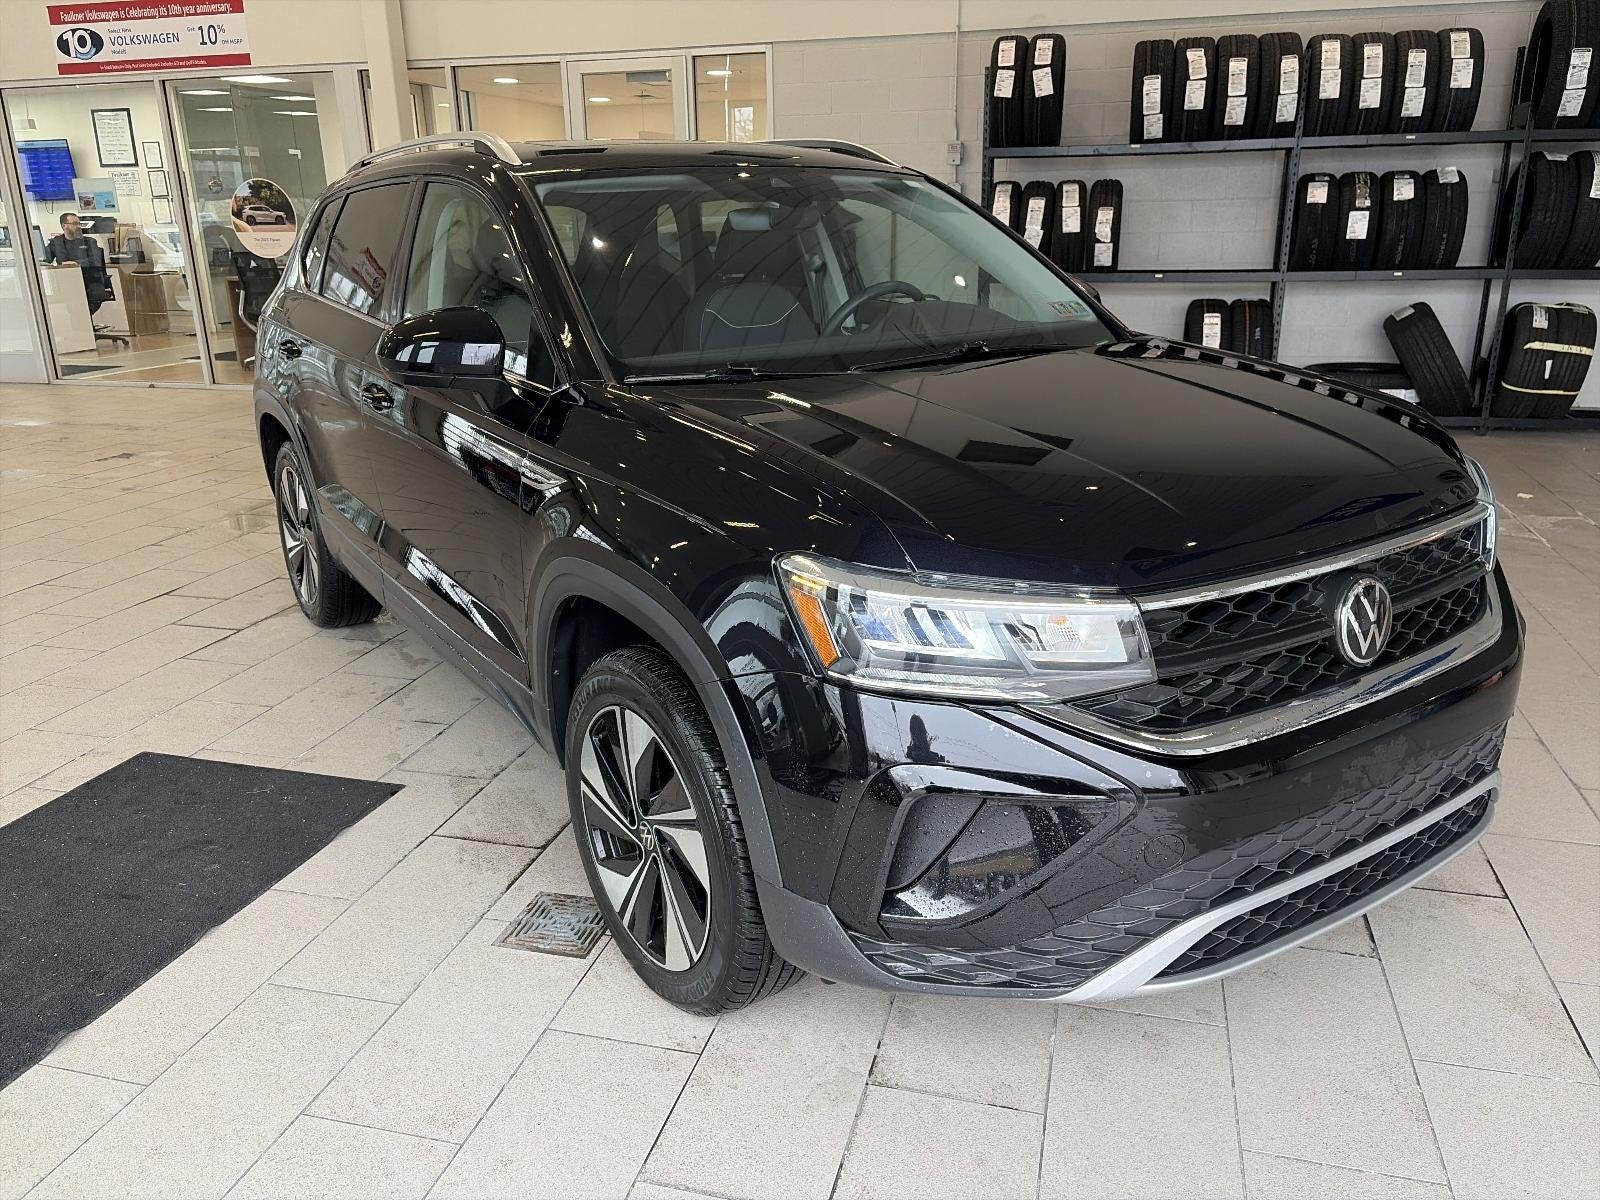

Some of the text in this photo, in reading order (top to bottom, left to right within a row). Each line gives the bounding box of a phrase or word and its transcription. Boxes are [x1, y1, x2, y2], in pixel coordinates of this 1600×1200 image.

[60, 11, 84, 21] Faulkner
[85, 10, 119, 21] Volkswagen
[120, 8, 125, 18] is
[126, 6, 158, 19] Celebrating
[168, 4, 182, 15] 10th
[182, 6, 195, 16] year
[196, 2, 232, 14] anniversary.
[62, 29, 92, 58] 10
[109, 32, 180, 47] VOLKSWAGEN
